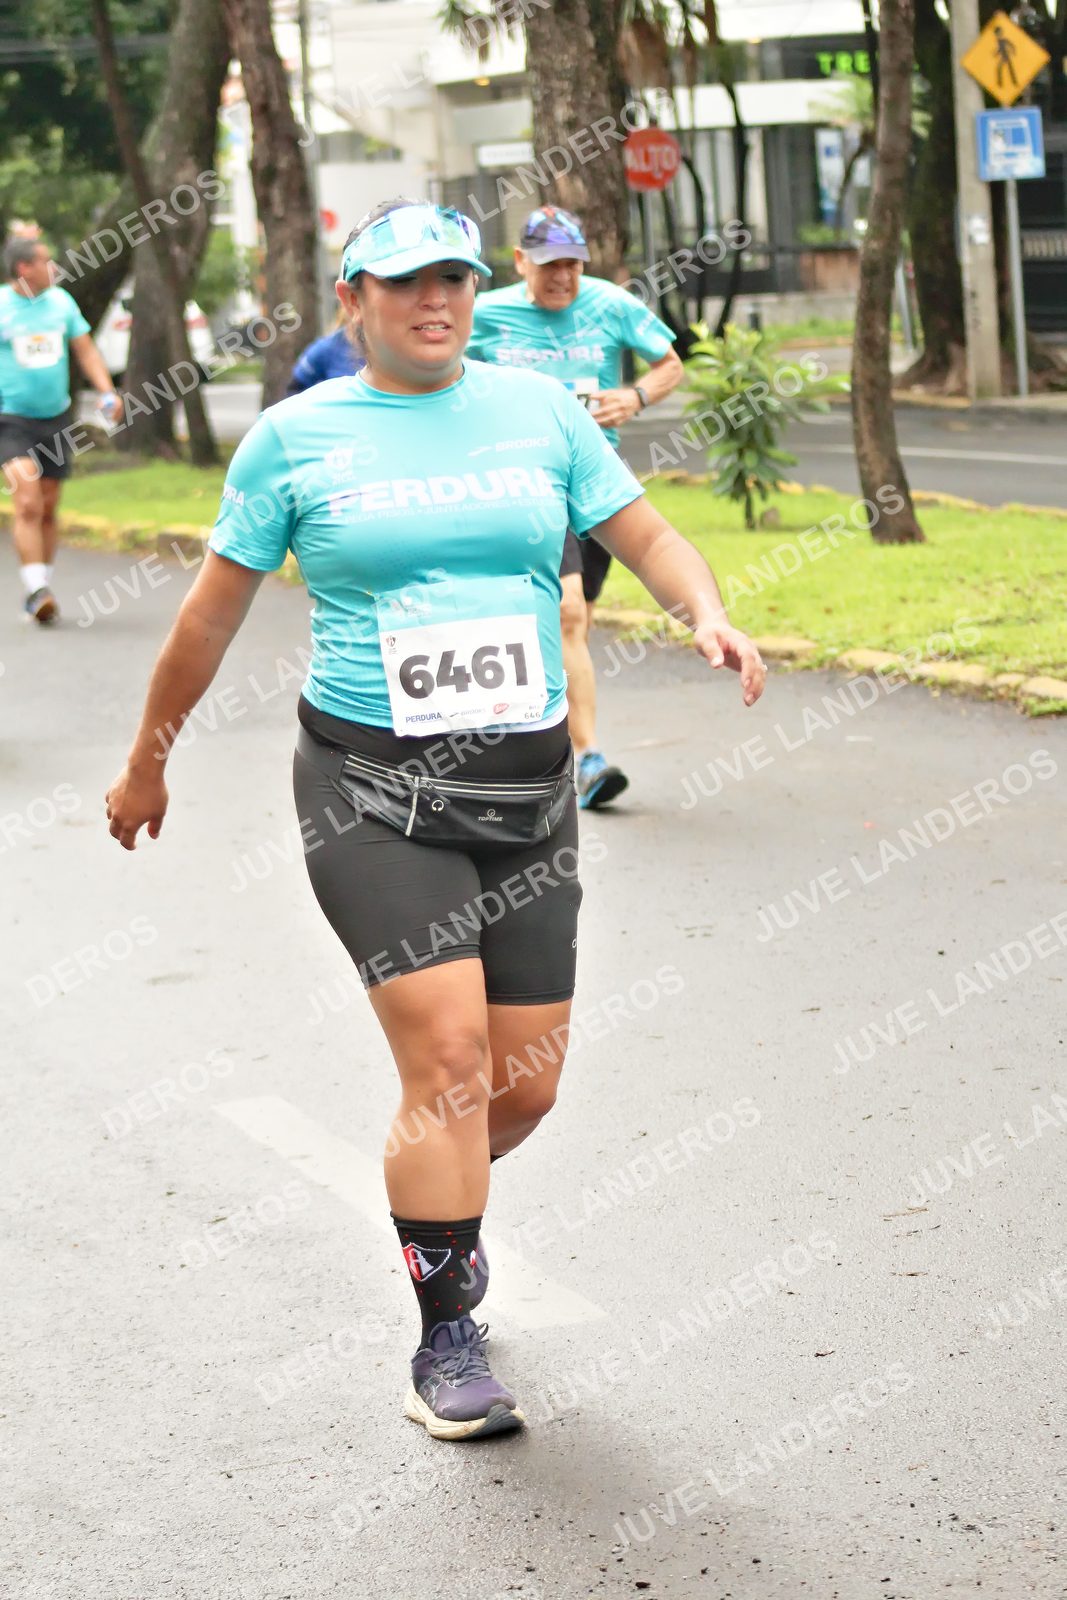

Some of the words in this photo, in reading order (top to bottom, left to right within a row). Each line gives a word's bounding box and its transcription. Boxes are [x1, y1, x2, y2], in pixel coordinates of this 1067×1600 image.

[624, 144, 677, 176] ALTO
[495, 437, 551, 452] BROOKS
[327, 466, 557, 517] PERDURA
[399, 642, 528, 699] 6461
[405, 712, 443, 724] PERDURA
